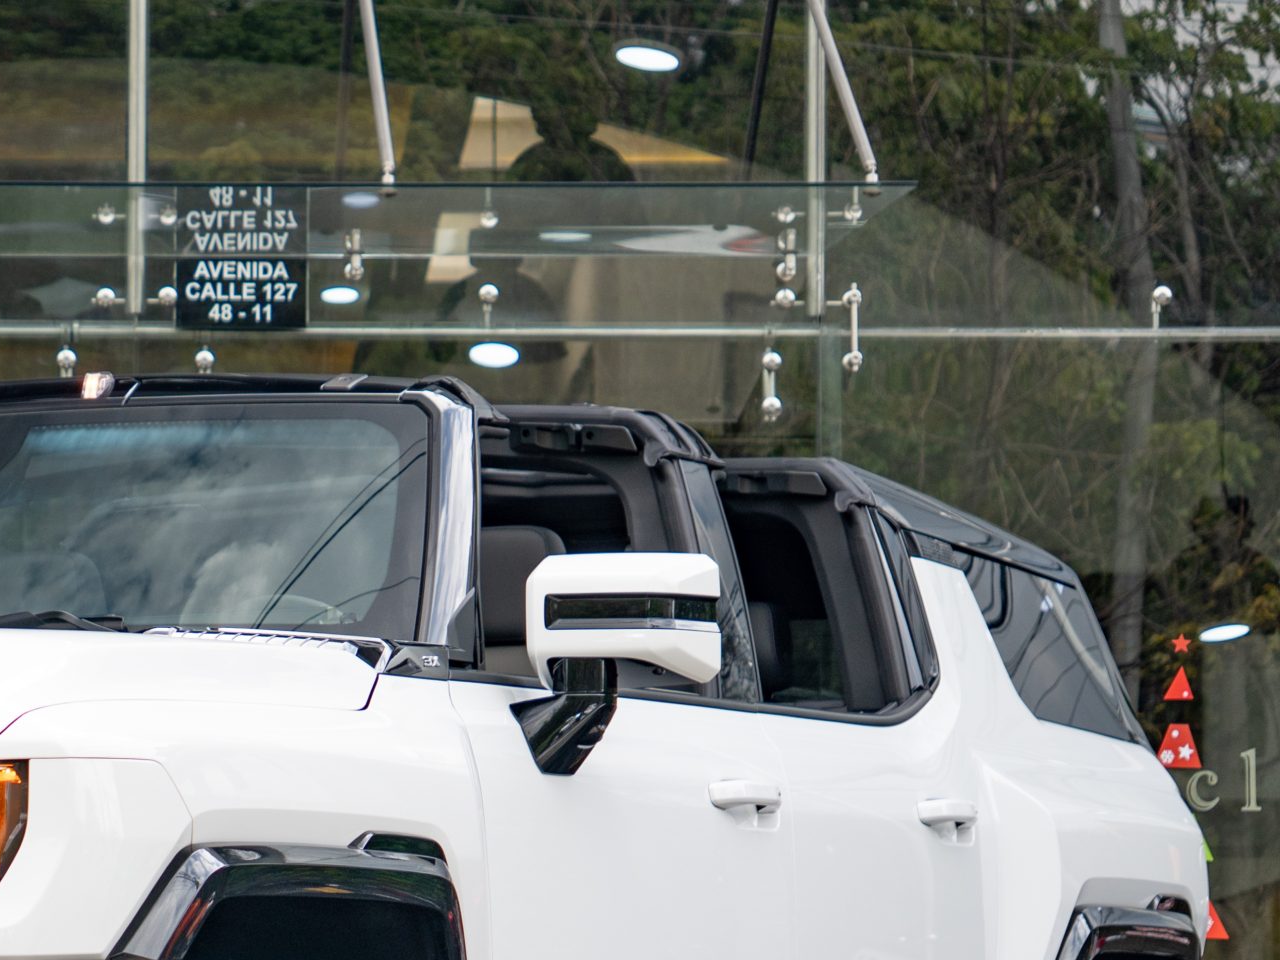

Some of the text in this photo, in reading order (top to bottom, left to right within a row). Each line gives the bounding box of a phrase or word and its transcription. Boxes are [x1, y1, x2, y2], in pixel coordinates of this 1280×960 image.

[194, 261, 289, 280] AVENIDA
[185, 282, 298, 301] CALLE 127
[208, 304, 233, 322] 48
[251, 304, 272, 322] 11
